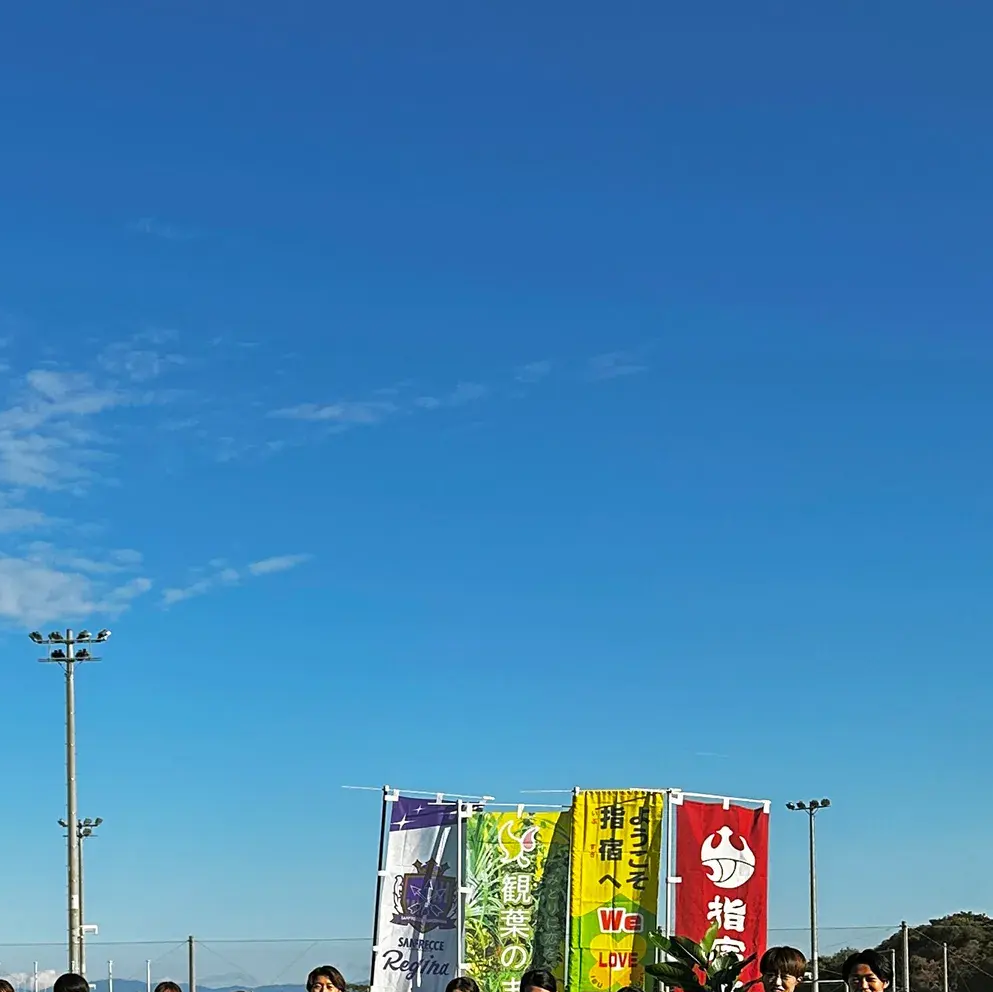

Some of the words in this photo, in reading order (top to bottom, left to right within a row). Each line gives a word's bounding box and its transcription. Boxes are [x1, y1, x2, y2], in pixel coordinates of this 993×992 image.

[599, 806, 626, 889] 指宿へ
[626, 807, 650, 890] ようこそ
[598, 909, 642, 932] We
[398, 937, 444, 951] SANFRECCE
[382, 949, 450, 980] Regina
[598, 952, 638, 968] LOVE
